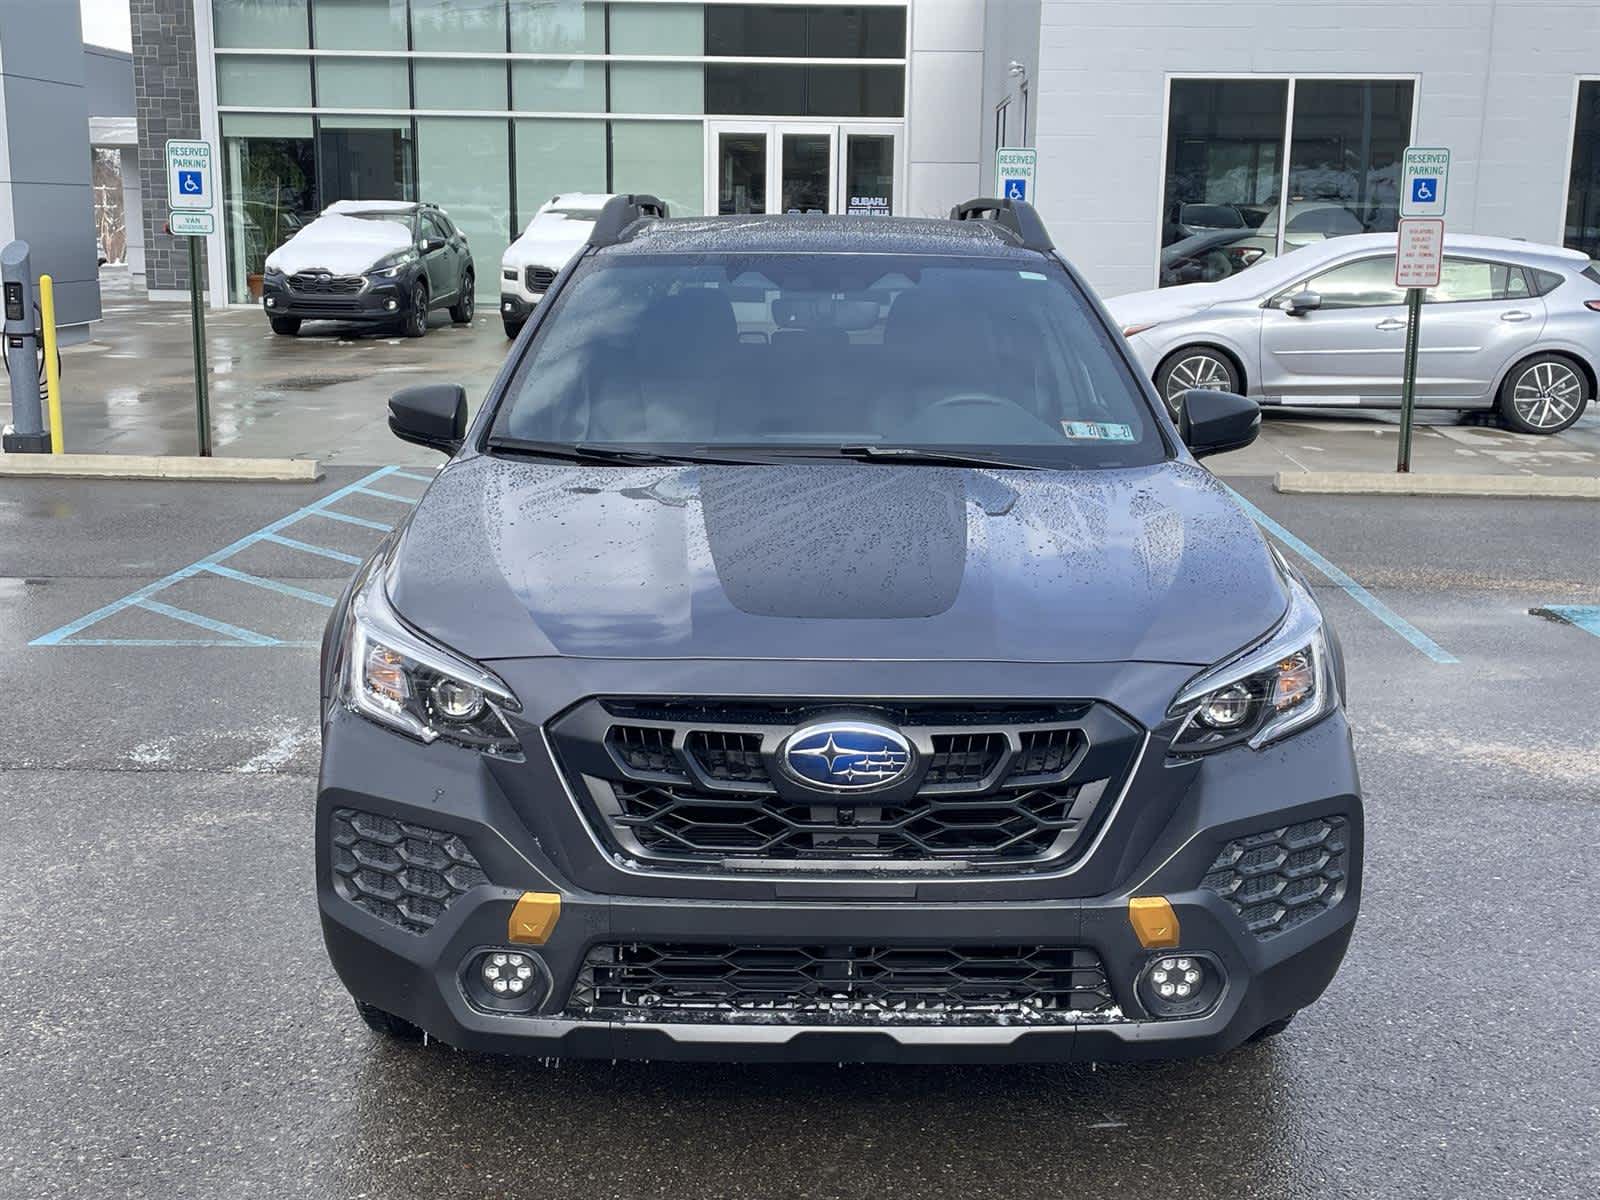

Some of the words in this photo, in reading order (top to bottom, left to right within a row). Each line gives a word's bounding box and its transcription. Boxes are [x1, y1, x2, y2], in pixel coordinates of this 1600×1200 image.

[170, 146, 208, 157] RESERVED
[1000, 155, 1035, 164] RESERVED
[1408, 154, 1447, 164] RESERVED
[173, 159, 207, 169] PARKING
[1001, 166, 1031, 176] PARKING
[1409, 166, 1444, 175] PARKING
[851, 197, 888, 206] SUBARU
[185, 217, 201, 225] VAN
